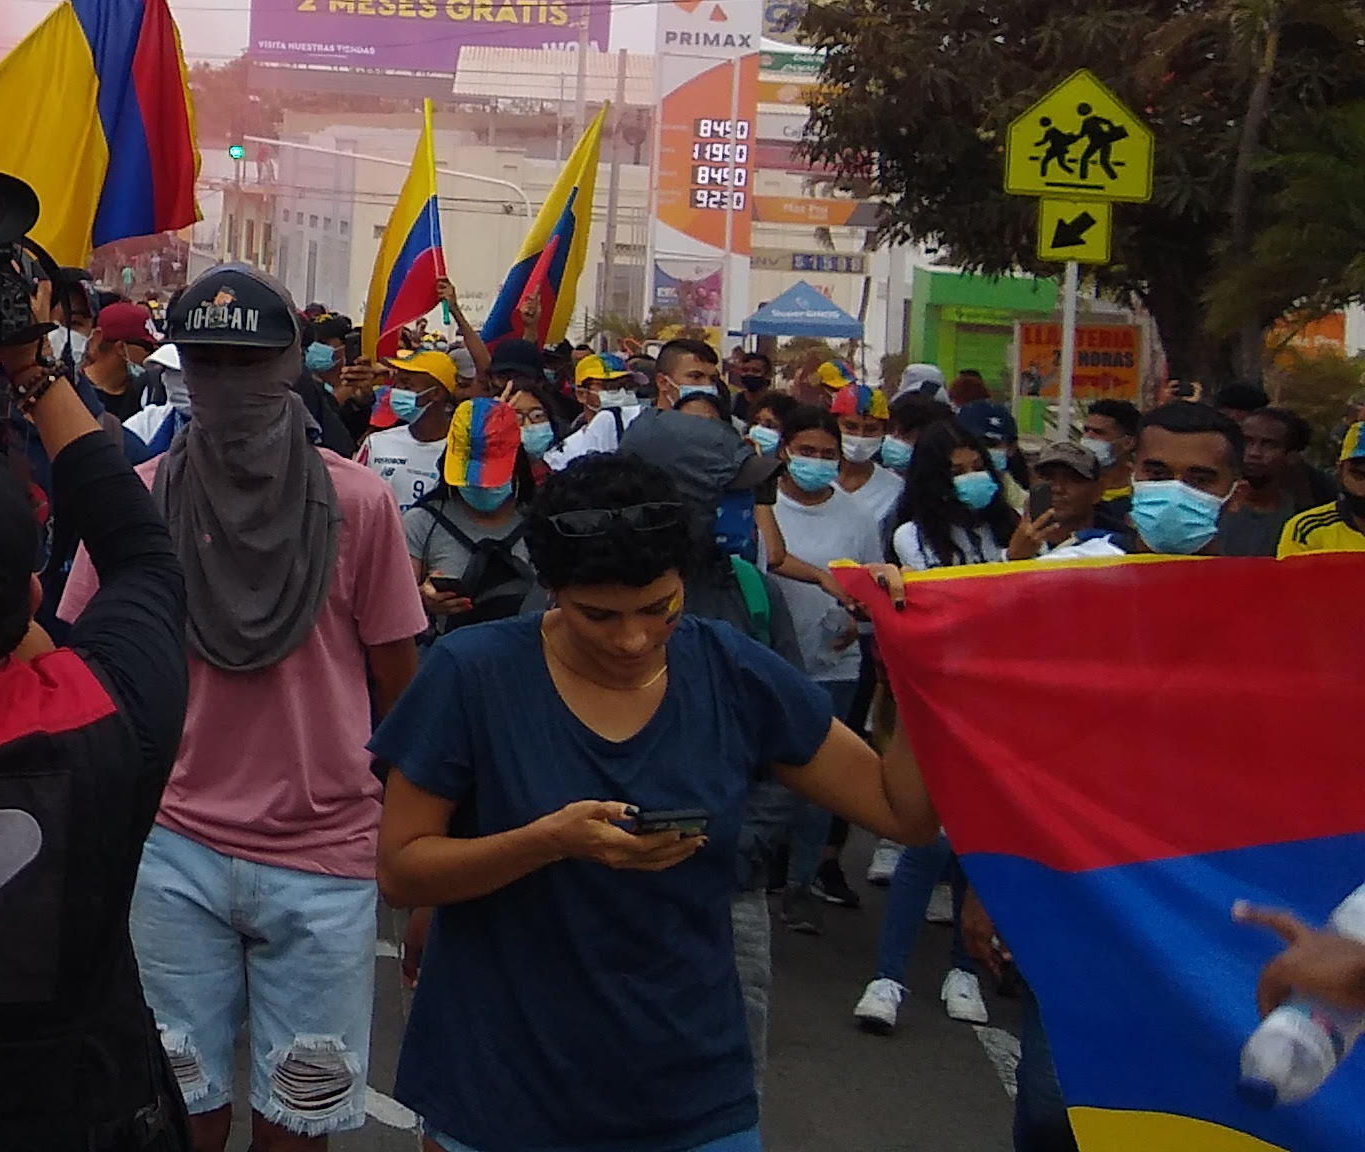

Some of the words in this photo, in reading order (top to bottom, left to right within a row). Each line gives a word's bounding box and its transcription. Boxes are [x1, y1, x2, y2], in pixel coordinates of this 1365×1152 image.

[258, 40, 286, 50] VISITA
[288, 41, 335, 52] NUESTRAS
[337, 44, 376, 56] TIENDAS
[665, 31, 752, 48] PRIMAX
[1024, 324, 1135, 348] LLATERIA
[1077, 350, 1135, 368] HORAS
[412, 480, 425, 499] 9
